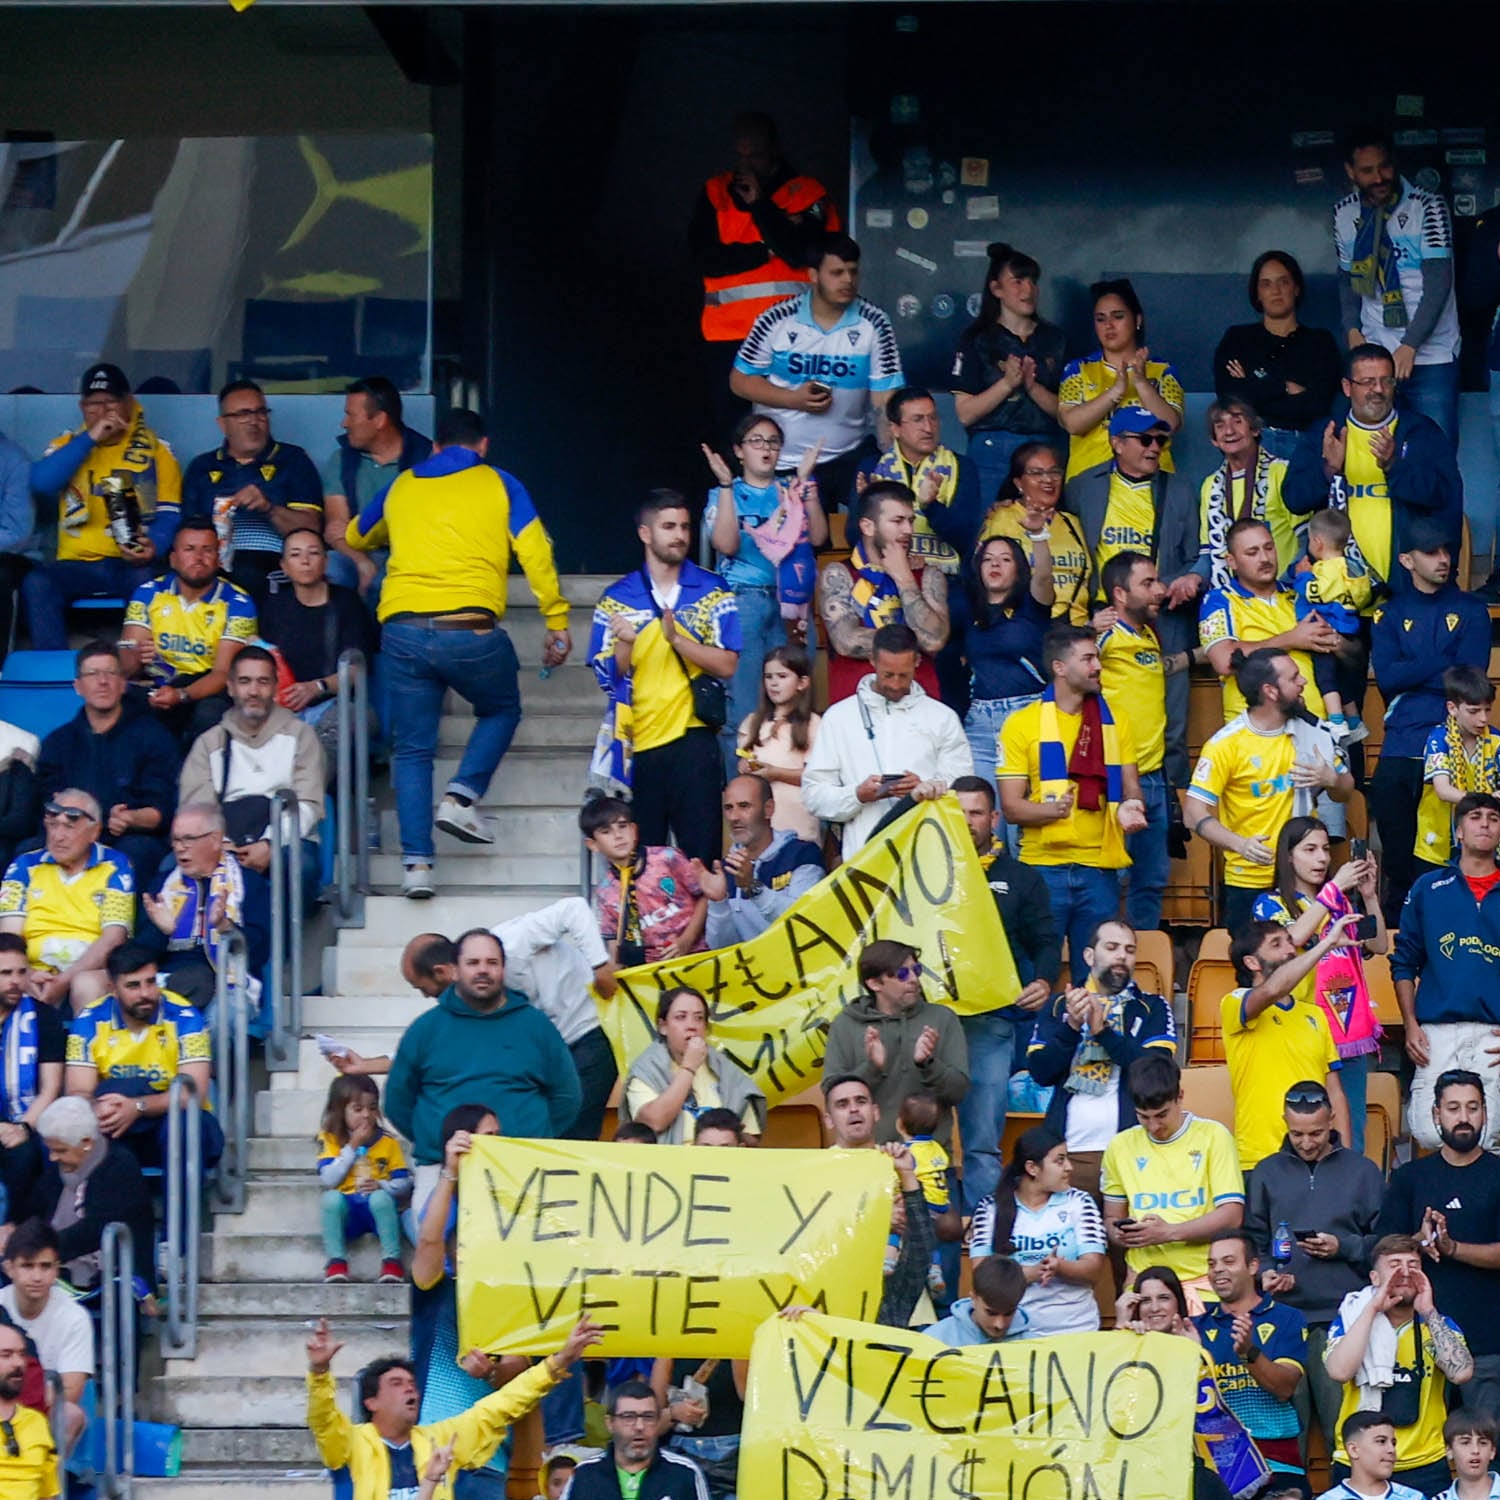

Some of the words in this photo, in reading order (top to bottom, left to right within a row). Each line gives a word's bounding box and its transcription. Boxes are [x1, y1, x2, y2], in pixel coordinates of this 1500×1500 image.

[483, 1165, 732, 1248] VENDE
[778, 1183, 833, 1255] Y
[1133, 1187, 1205, 1211] DIGI
[523, 1260, 722, 1338] VETE
